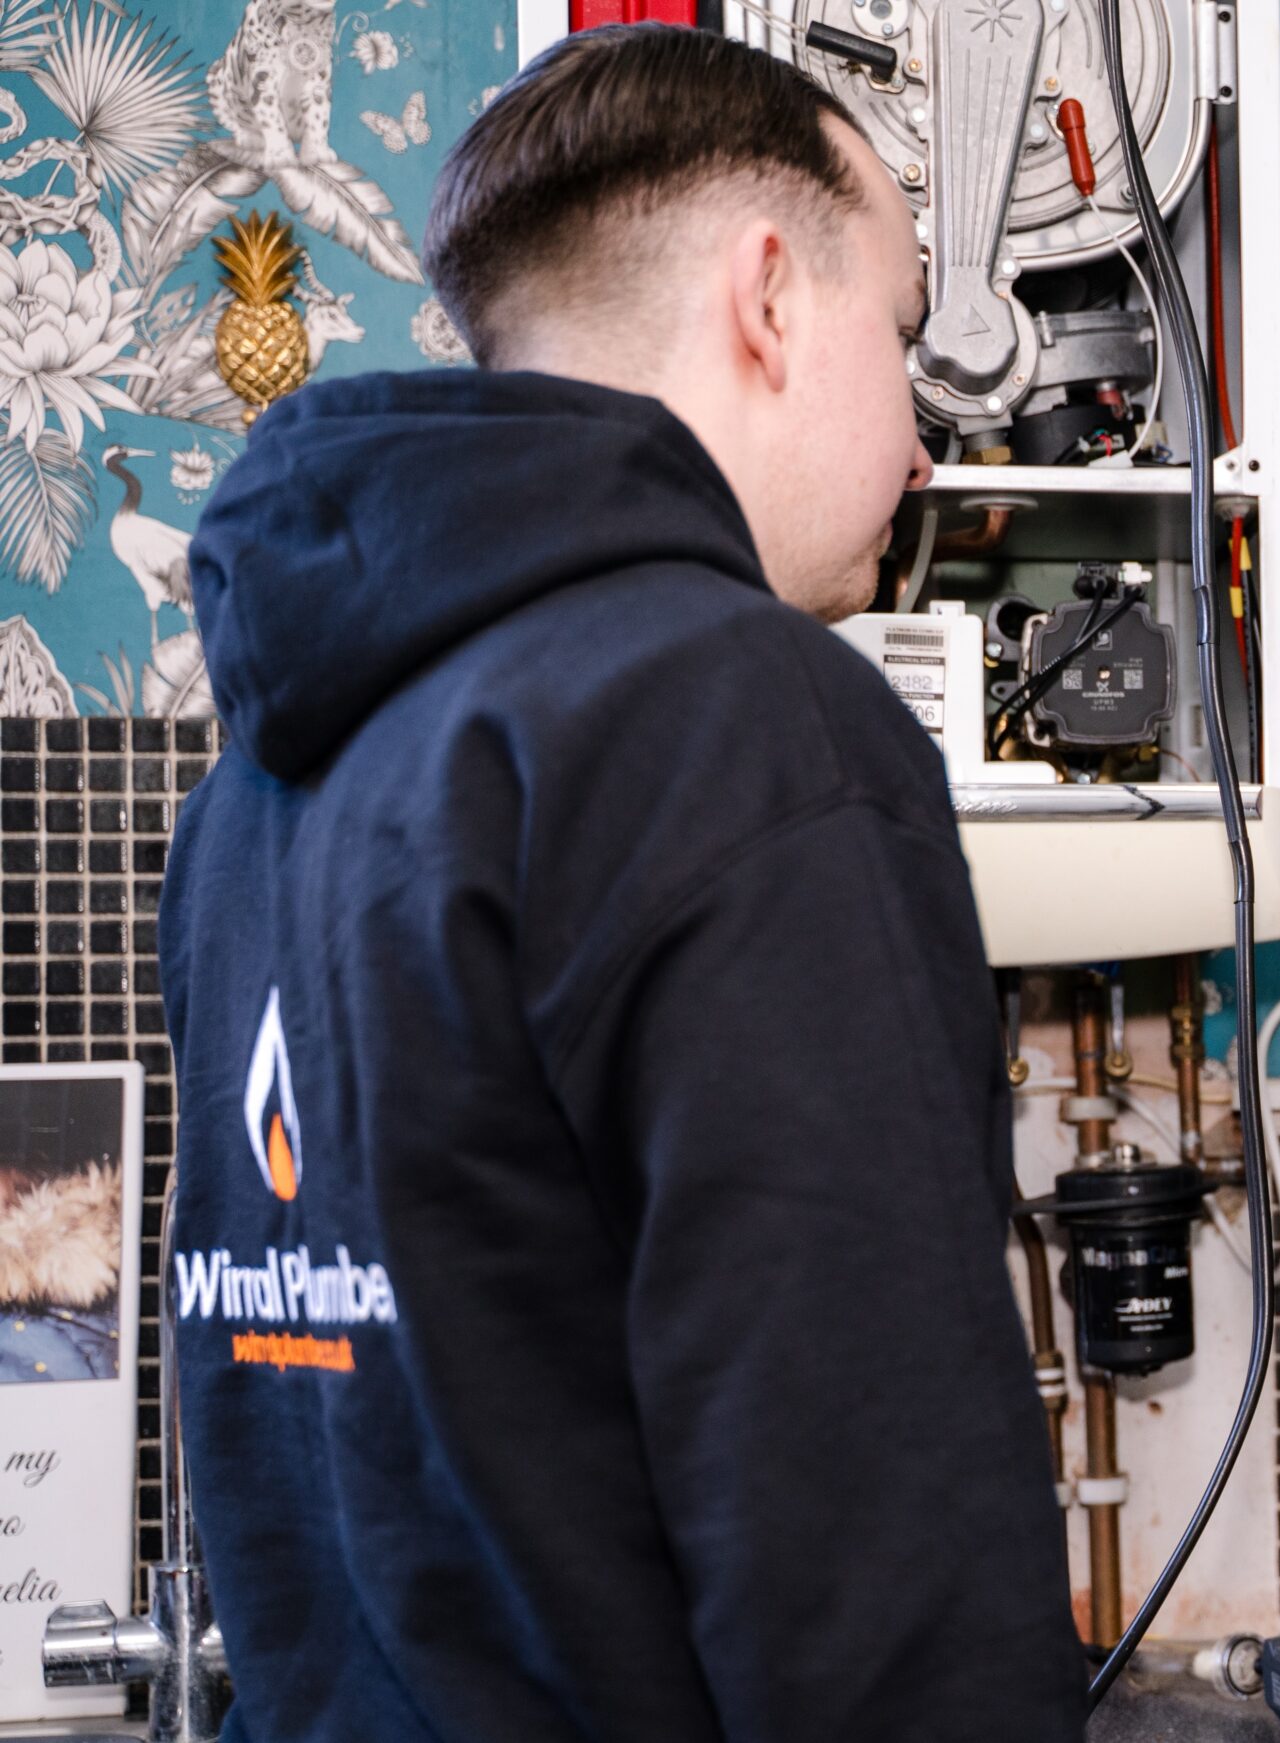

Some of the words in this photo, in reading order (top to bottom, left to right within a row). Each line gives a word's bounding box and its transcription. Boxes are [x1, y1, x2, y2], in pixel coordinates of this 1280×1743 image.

[890, 674, 933, 690] 2482
[4, 1450, 61, 1488] my
[0, 1566, 62, 1604] elia
